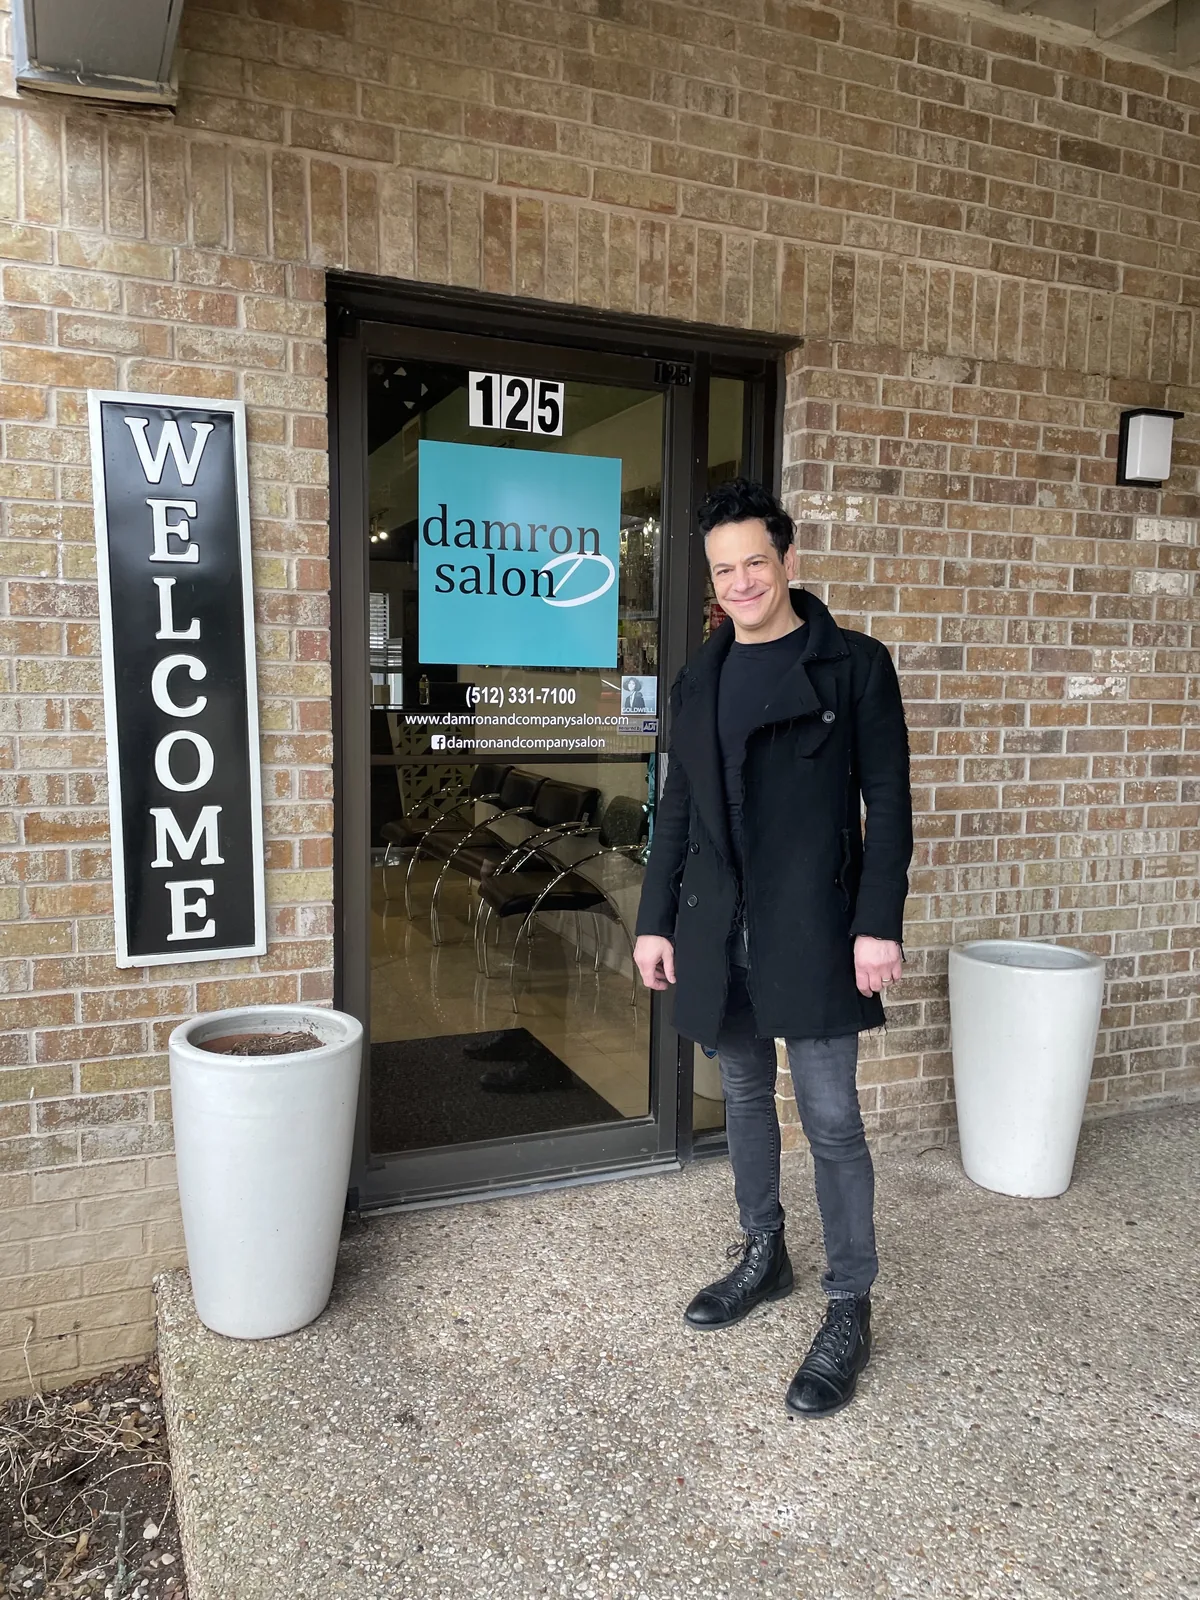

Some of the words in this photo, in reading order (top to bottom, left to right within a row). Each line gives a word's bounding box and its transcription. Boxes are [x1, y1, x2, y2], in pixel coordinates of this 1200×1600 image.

[658, 364, 688, 386] 125
[475, 375, 560, 433] 125
[422, 503, 602, 556] damron
[434, 553, 556, 598] salon
[123, 416, 225, 941] WELCOME
[465, 686, 505, 708] (512)
[508, 687, 576, 704] 331-7100
[405, 712, 629, 728] www.damronandcompanysalon.com
[447, 736, 605, 751] damronandcompanysalon
